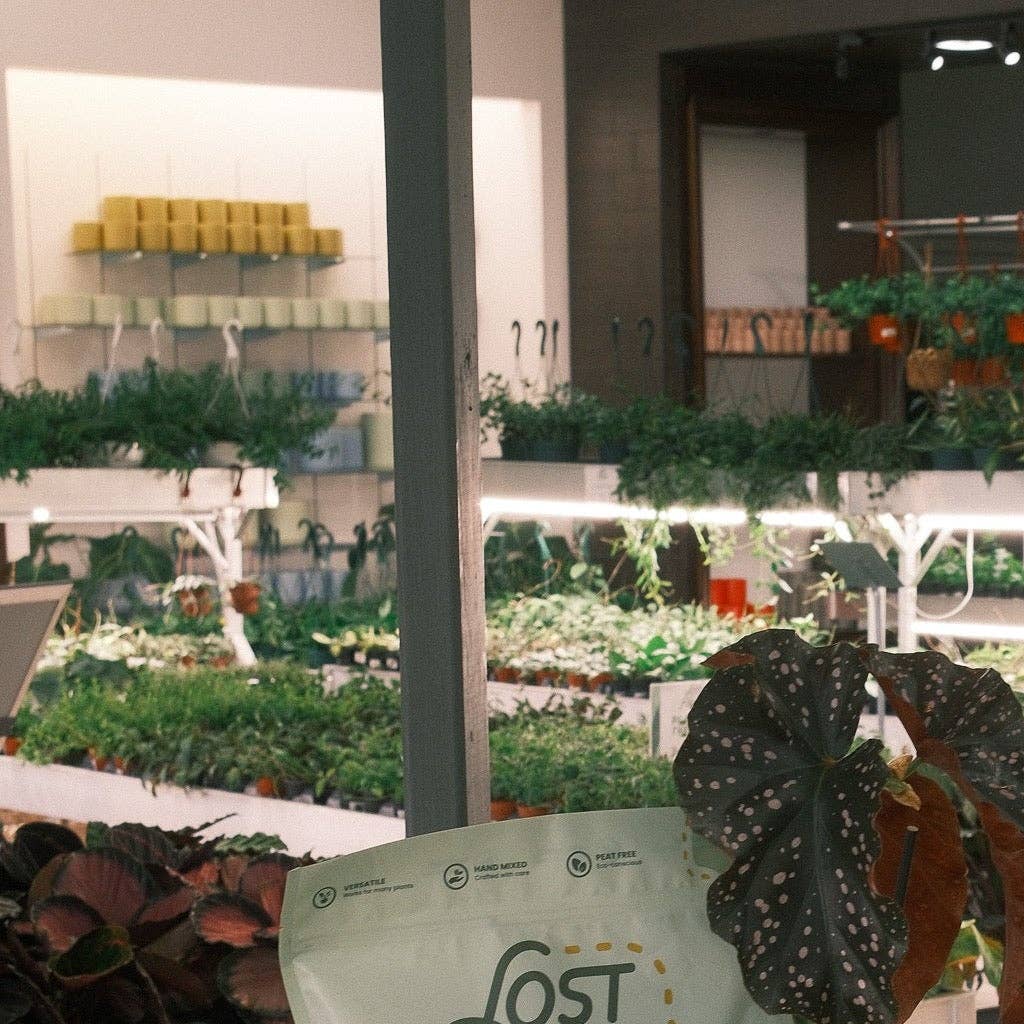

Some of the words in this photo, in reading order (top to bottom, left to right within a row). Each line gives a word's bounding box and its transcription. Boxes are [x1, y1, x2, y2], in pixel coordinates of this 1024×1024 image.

[595, 852, 616, 862] PEAT
[617, 850, 638, 860] FREE
[473, 863, 499, 873] HAND
[500, 860, 528, 871] MIXED
[343, 877, 386, 892] VERSATILE
